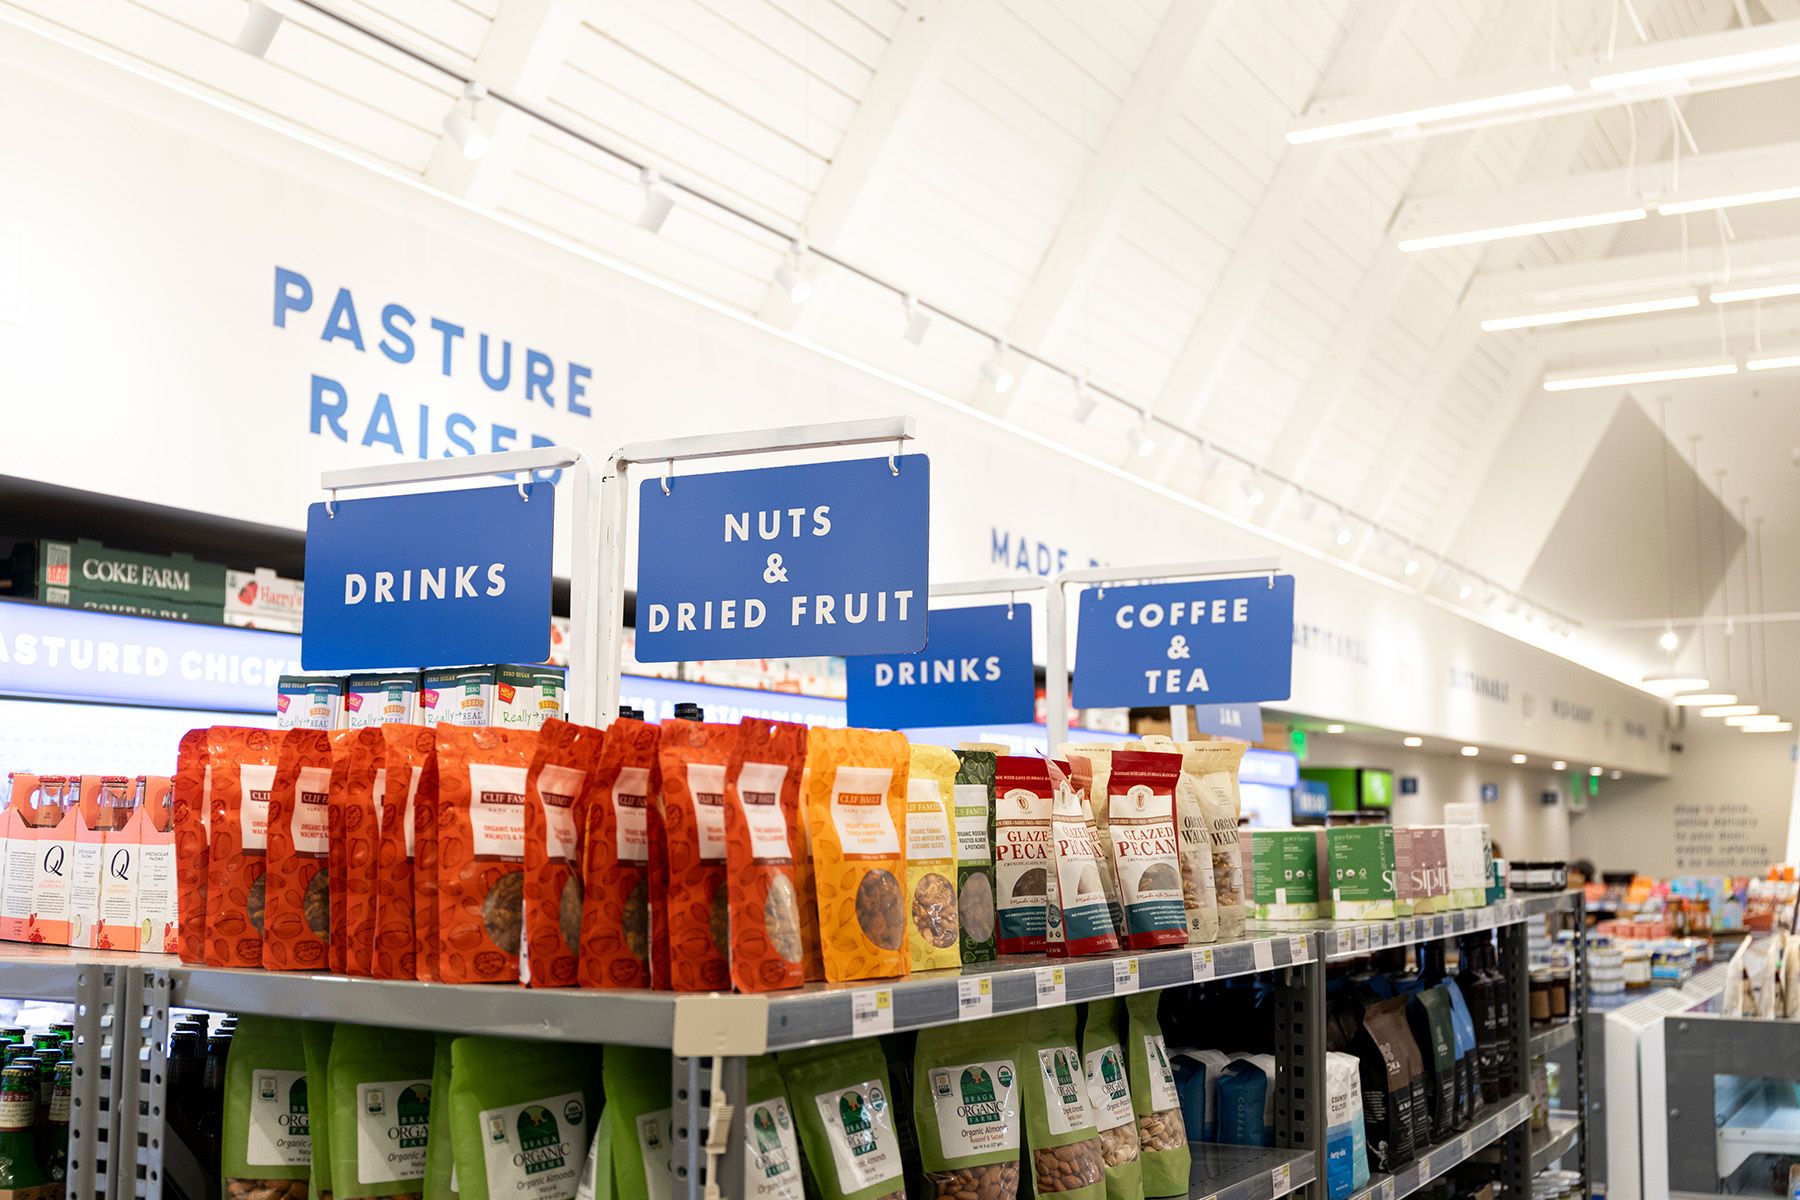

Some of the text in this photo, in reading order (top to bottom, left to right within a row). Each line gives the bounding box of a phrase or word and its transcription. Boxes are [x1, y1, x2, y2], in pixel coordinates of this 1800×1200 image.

[273, 265, 592, 418] PASTURE
[724, 506, 832, 543] NUTS
[82, 558, 138, 585] COKE
[141, 565, 190, 592] FARM
[763, 553, 789, 584] &
[345, 562, 507, 605] DRINKS
[648, 590, 914, 633] DRIED FRUIT
[1115, 598, 1249, 630] COFFEE
[1167, 634, 1191, 660] &
[875, 656, 1002, 687] DRINKS
[1145, 667, 1210, 694] TEA
[351, 712, 377, 728] Really
[428, 709, 455, 724] Really
[502, 708, 532, 726] Really
[482, 792, 505, 803] CLIF
[1123, 826, 1174, 841] GLAZED
[996, 843, 1048, 861] PECA
[1116, 839, 1177, 858] PECAN
[43, 844, 65, 877] Q
[110, 848, 130, 881] Q
[964, 1093, 995, 1103] BRAGA
[956, 1100, 1004, 1118] ORGANIC
[967, 1114, 999, 1124] FARMS
[960, 1127, 984, 1138] Organic
[276, 1138, 307, 1150] Organic
[522, 1136, 558, 1150] BRAGA
[387, 1151, 419, 1163] Organic
[512, 1142, 572, 1167] ORGANIC
[527, 1159, 562, 1173] FARMS
[516, 1177, 546, 1191] Organic
